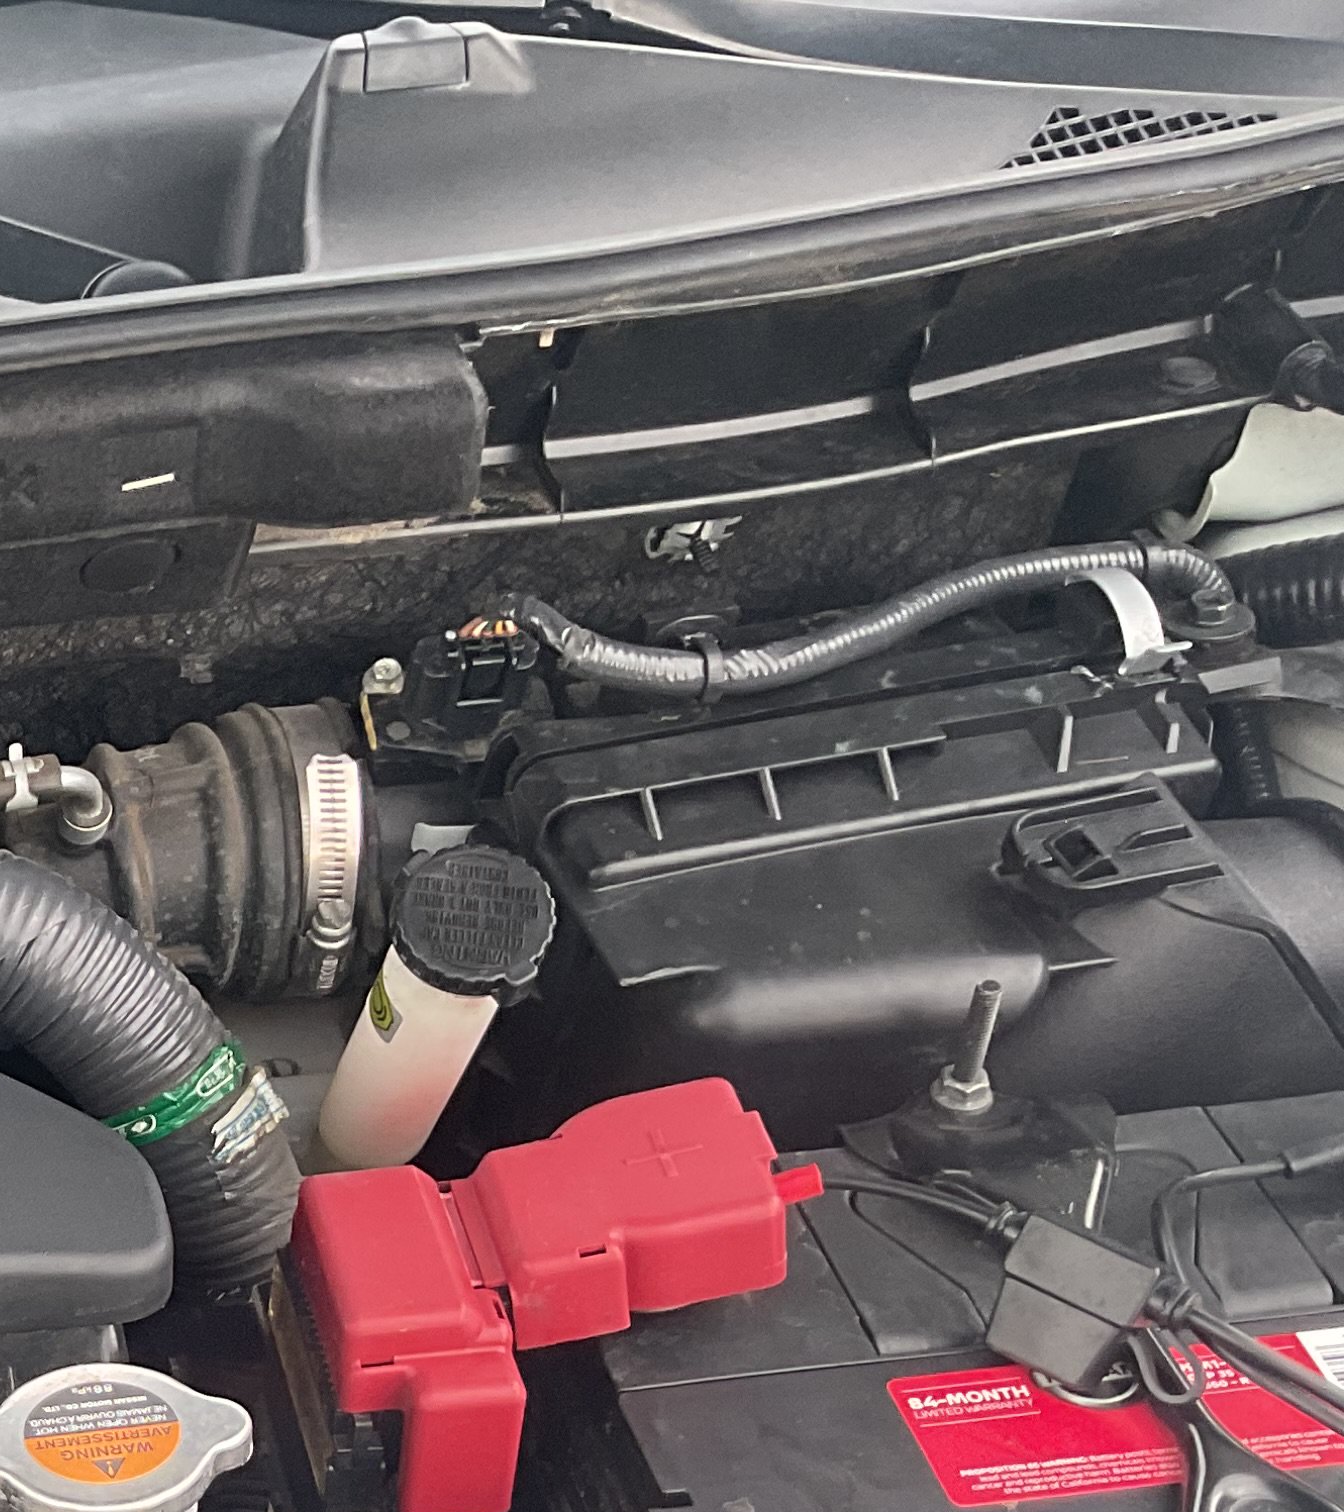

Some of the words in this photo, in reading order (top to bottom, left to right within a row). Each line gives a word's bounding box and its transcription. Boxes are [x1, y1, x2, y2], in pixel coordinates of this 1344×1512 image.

[907, 1383, 1031, 1411] 84-MONTH
[116, 1406, 150, 1417] JAMAIS
[152, 1404, 166, 1412] NE
[914, 1402, 964, 1420] LIMITED
[965, 1397, 1034, 1417] WARRANTY
[75, 1410, 114, 1421] OUVRIR
[130, 1413, 165, 1423] NEVER
[59, 1421, 94, 1432] WHEN
[97, 1417, 127, 1427] OPEN
[35, 1427, 170, 1448] AVERTISSEMENT
[63, 1441, 154, 1461] WARNING
